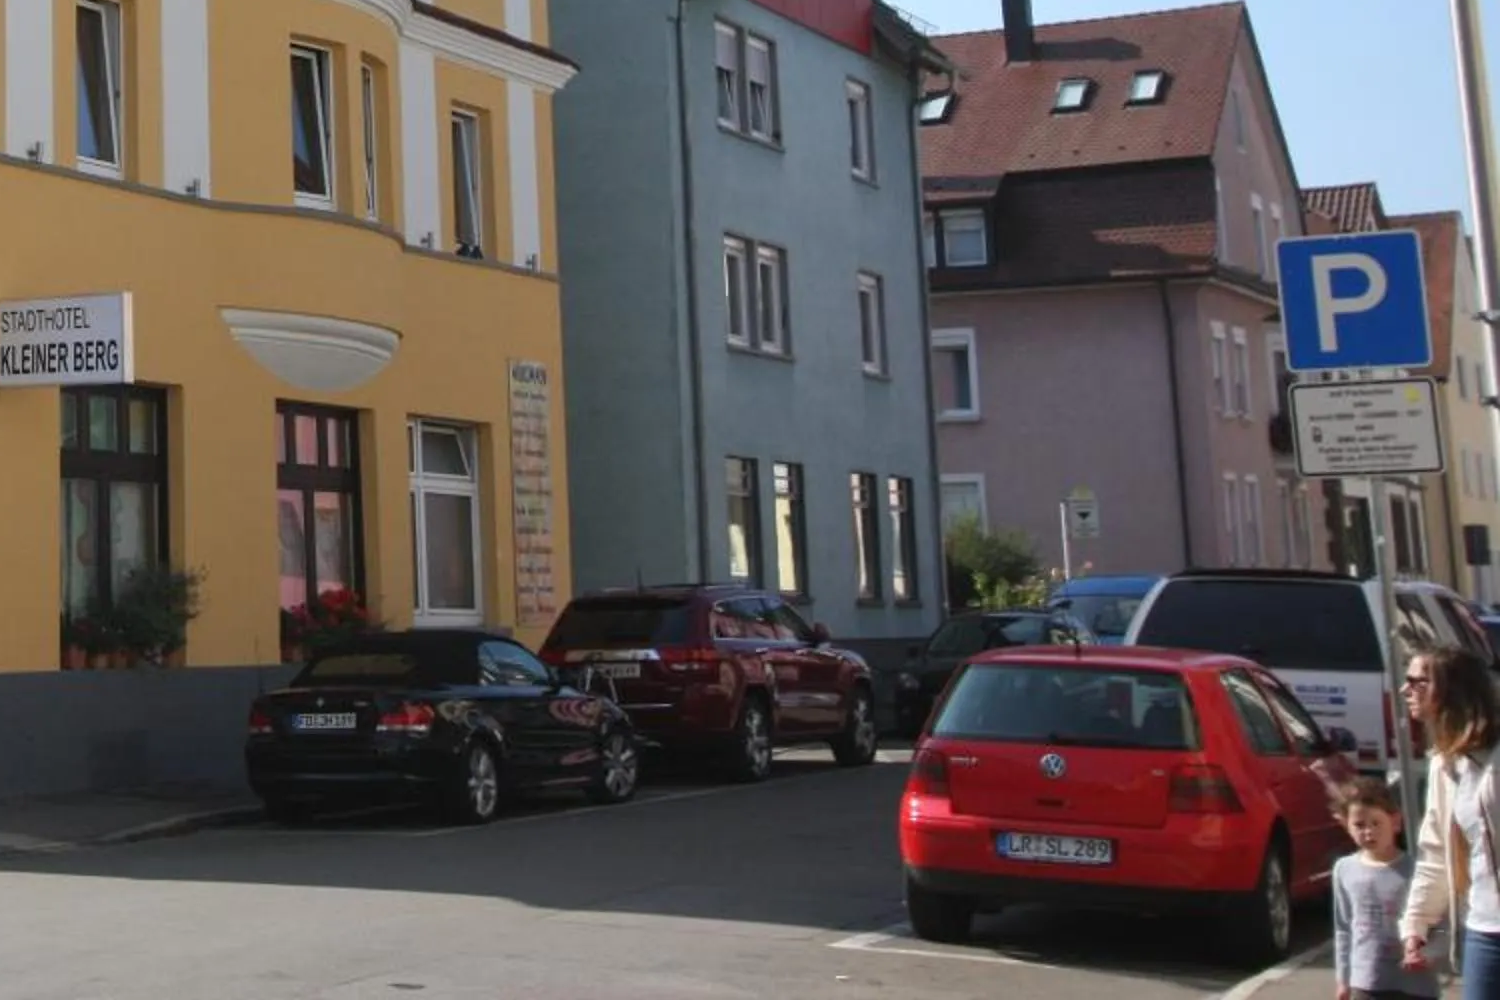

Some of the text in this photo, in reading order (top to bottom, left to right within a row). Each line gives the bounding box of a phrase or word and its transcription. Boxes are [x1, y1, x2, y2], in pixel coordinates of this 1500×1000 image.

[1311, 252, 1388, 353] P
[0, 307, 91, 333] STADTHOTEL
[0, 339, 119, 376] KLEINER BERG
[1008, 833, 1109, 859] LR SL 289
